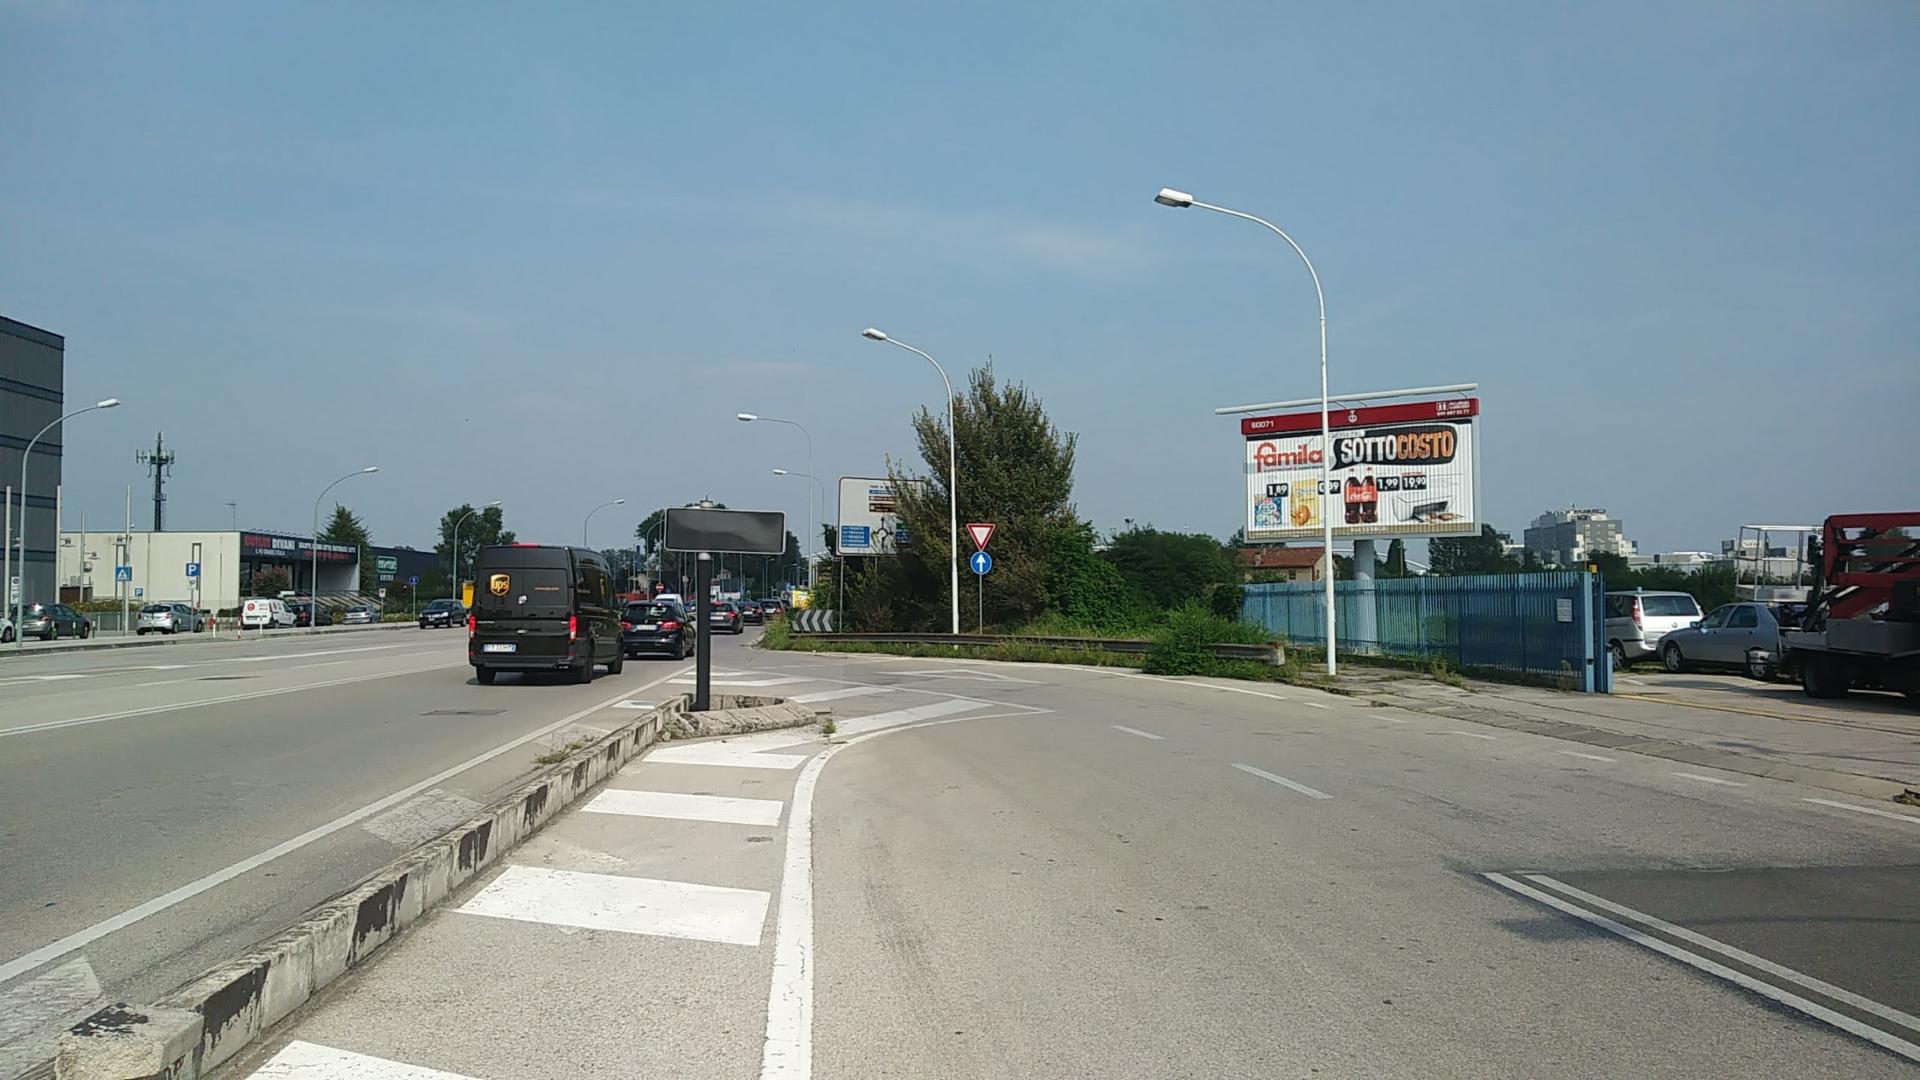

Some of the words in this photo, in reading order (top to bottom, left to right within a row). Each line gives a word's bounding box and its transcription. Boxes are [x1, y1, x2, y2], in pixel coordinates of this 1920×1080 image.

[1254, 442, 1323, 473] famila
[272, 538, 295, 550] DIVANI
[188, 564, 197, 575] P
[492, 580, 508, 592] ups
